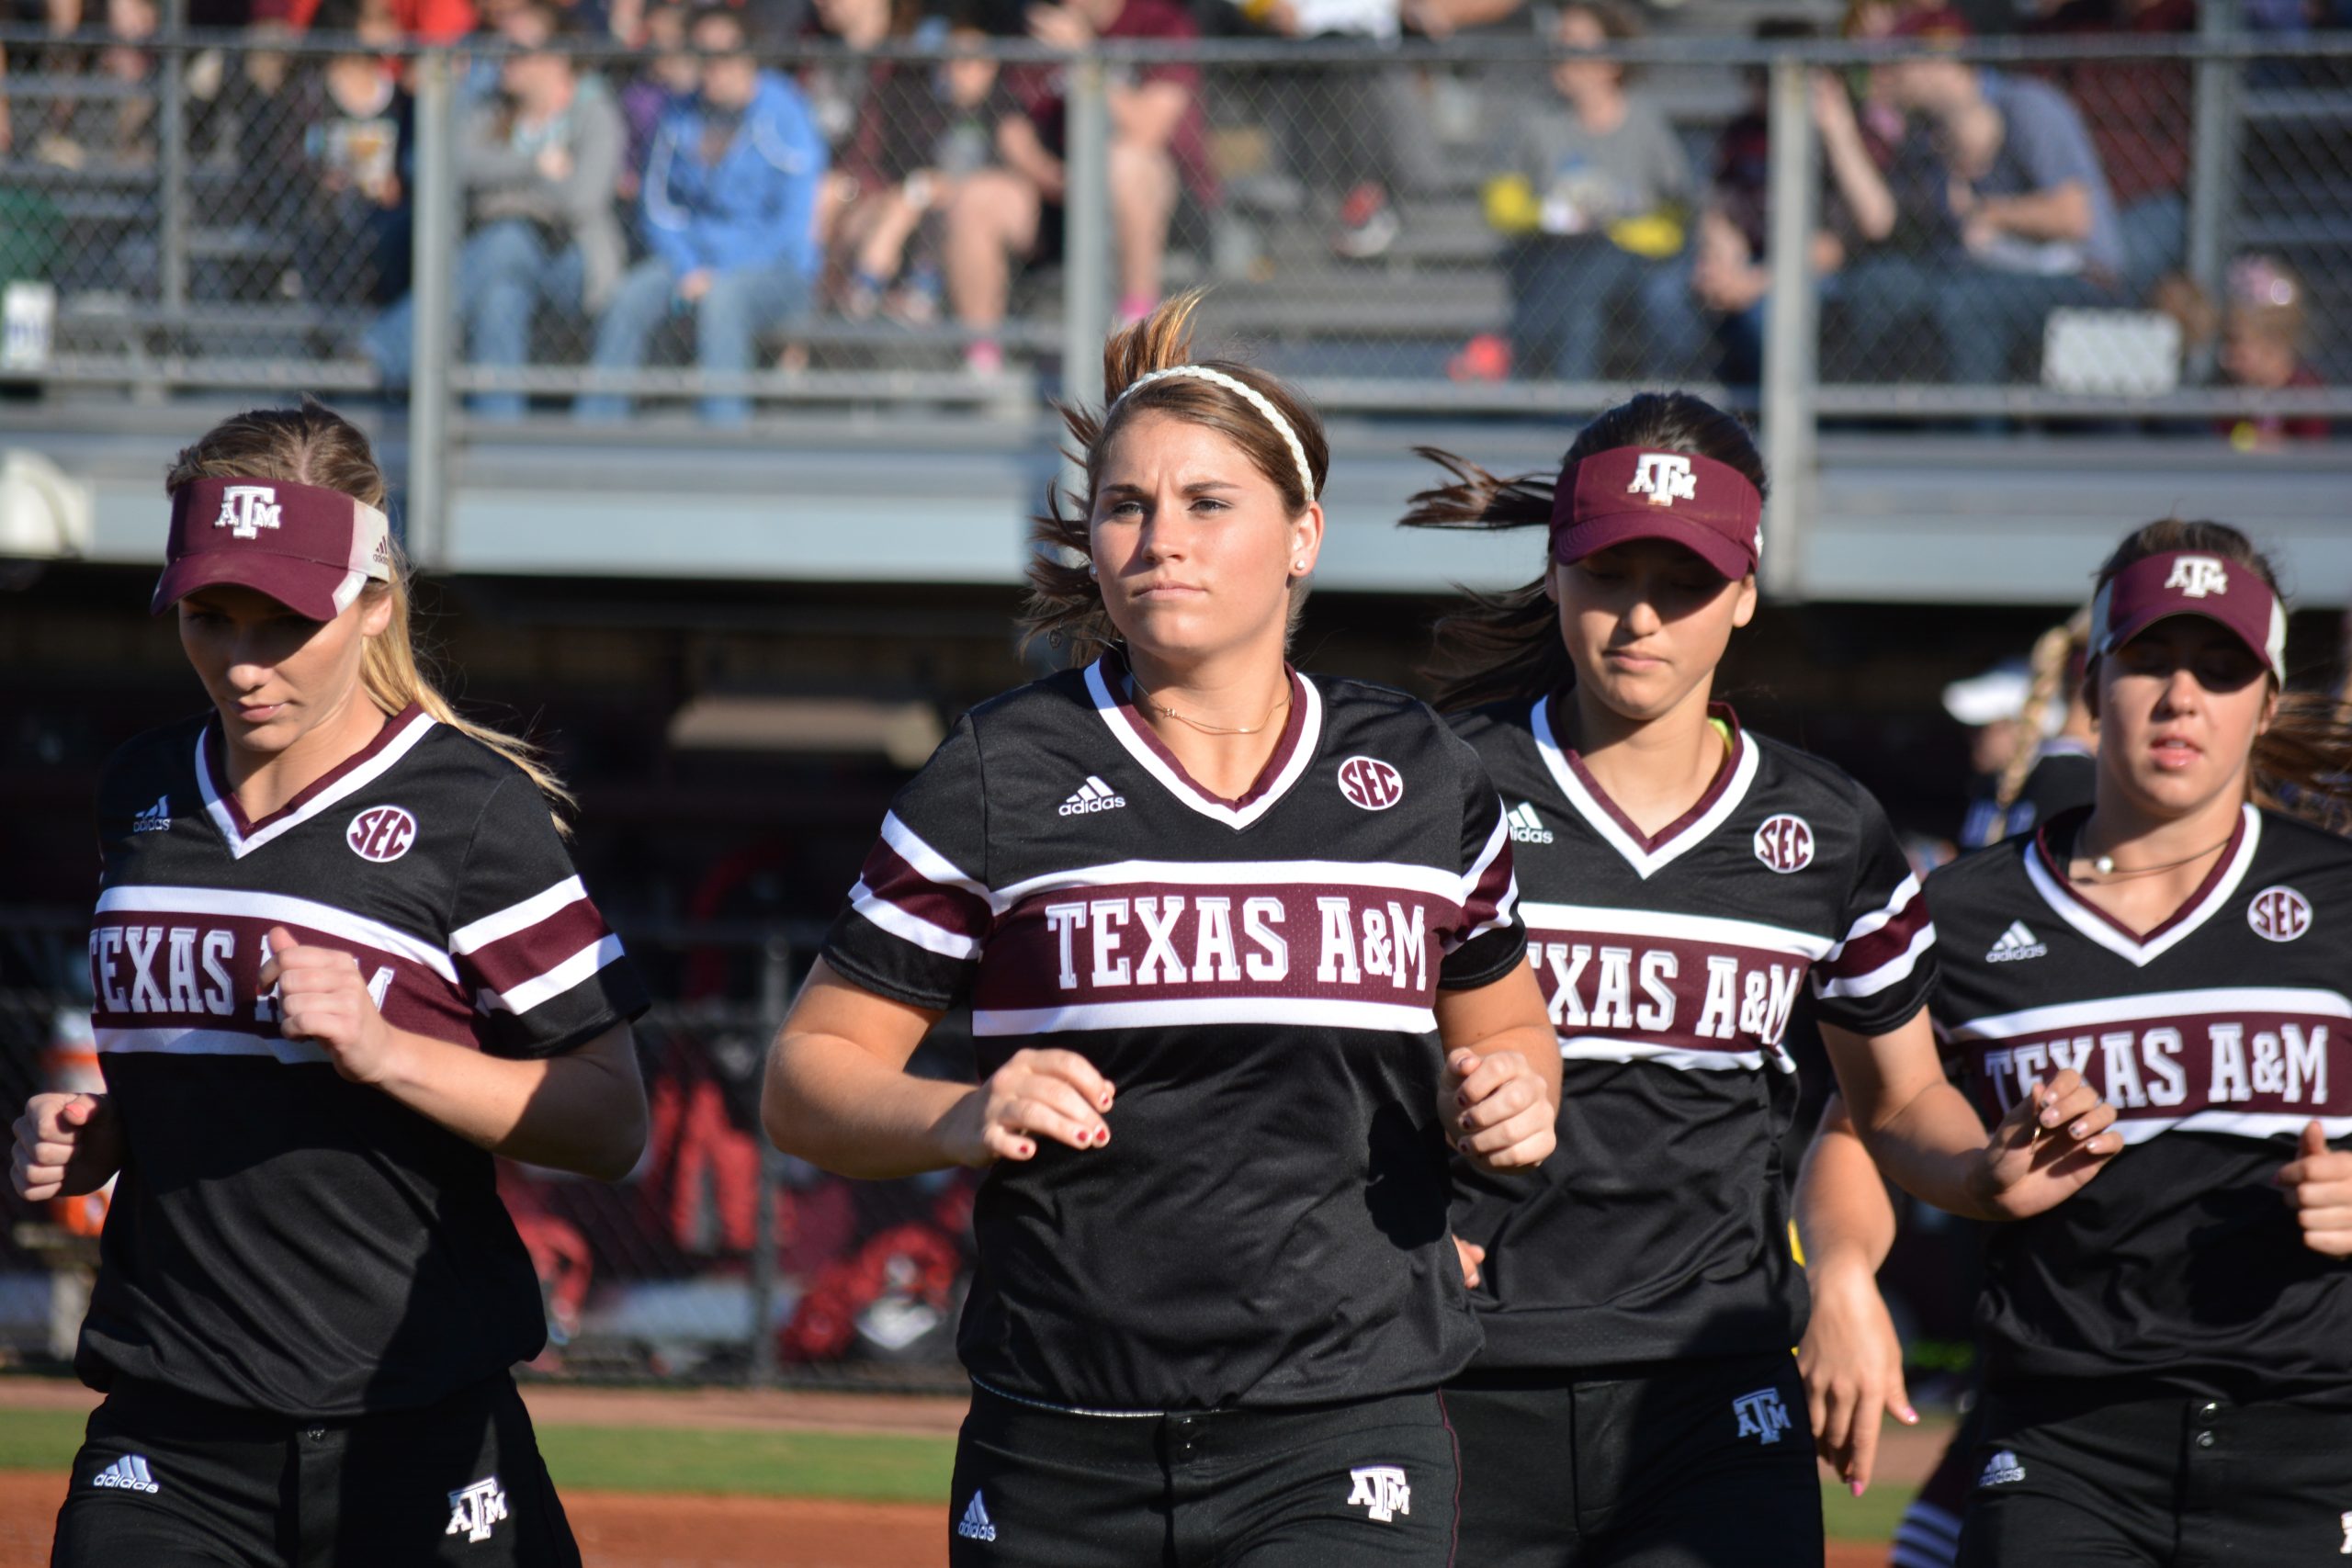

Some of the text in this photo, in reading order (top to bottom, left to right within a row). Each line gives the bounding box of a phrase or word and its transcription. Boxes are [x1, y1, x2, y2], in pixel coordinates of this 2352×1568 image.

[1058, 795, 1126, 816] adidas
[1340, 757, 1401, 807] SEC
[349, 807, 413, 860] SEC
[1510, 826, 1554, 844] idas
[1756, 817, 1811, 871] SEC
[2252, 889, 2308, 938] SEC
[1046, 896, 1427, 992] TEXAS A&M
[1985, 942, 2048, 964] adidas
[1528, 942, 1801, 1045] XAS A&M
[2208, 1021, 2329, 1105] A&M
[94, 1473, 160, 1494] adidas
